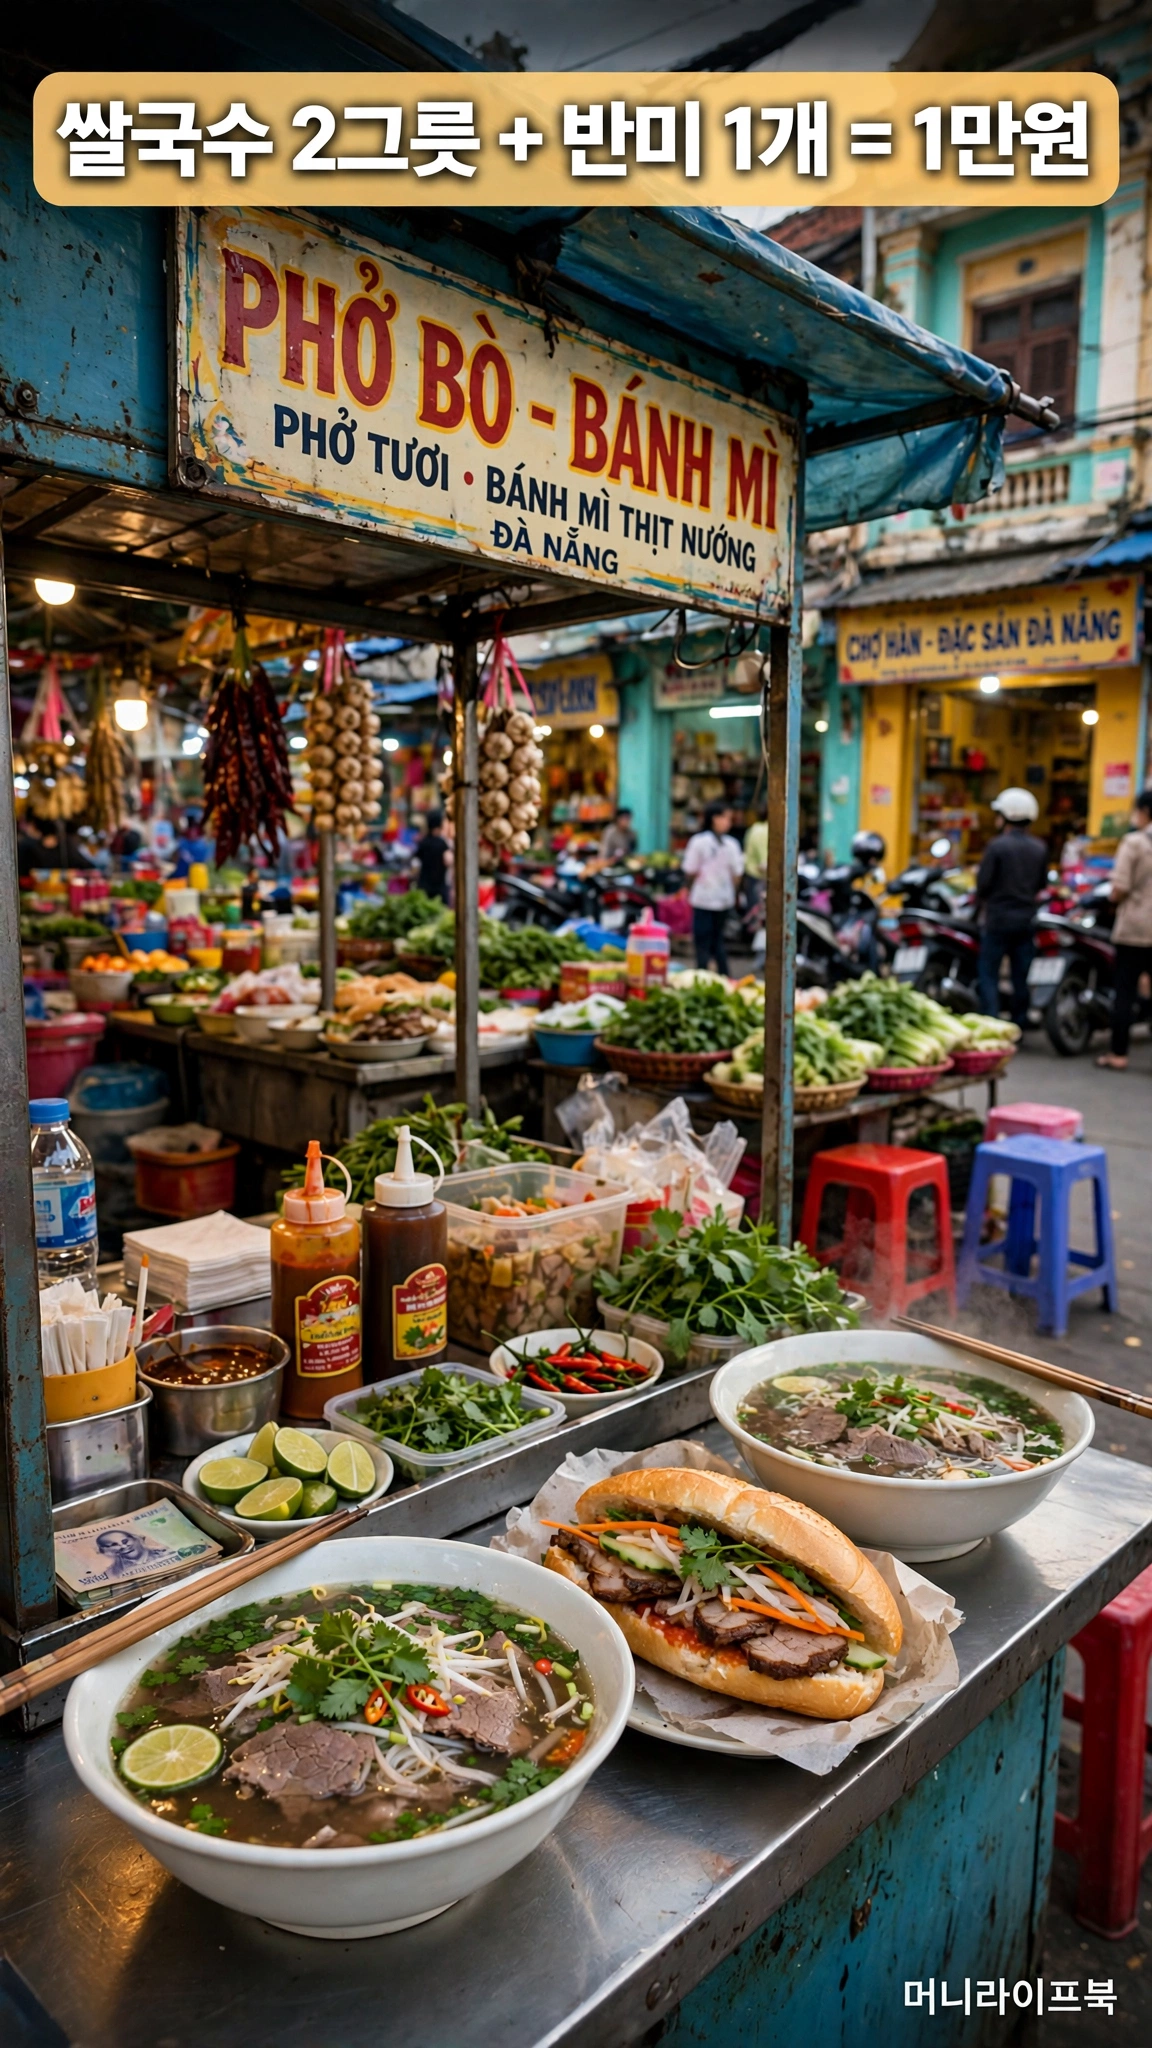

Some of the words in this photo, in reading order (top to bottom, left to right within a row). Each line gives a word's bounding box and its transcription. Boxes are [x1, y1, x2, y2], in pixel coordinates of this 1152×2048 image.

[221, 248, 397, 406] PHỞ
[419, 314, 512, 444] BÒ
[570, 375, 712, 508] BÁNH
[727, 429, 779, 530] MÌ
[274, 403, 357, 465] PHỞ
[367, 432, 449, 491] TƯƠI
[486, 462, 568, 521] BÁNH
[578, 487, 610, 532] MÌ
[619, 503, 674, 555] THỊT
[681, 524, 756, 573] NƯỚNG
[490, 517, 533, 555] ĐÀ
[543, 526, 618, 575] NẴNG
